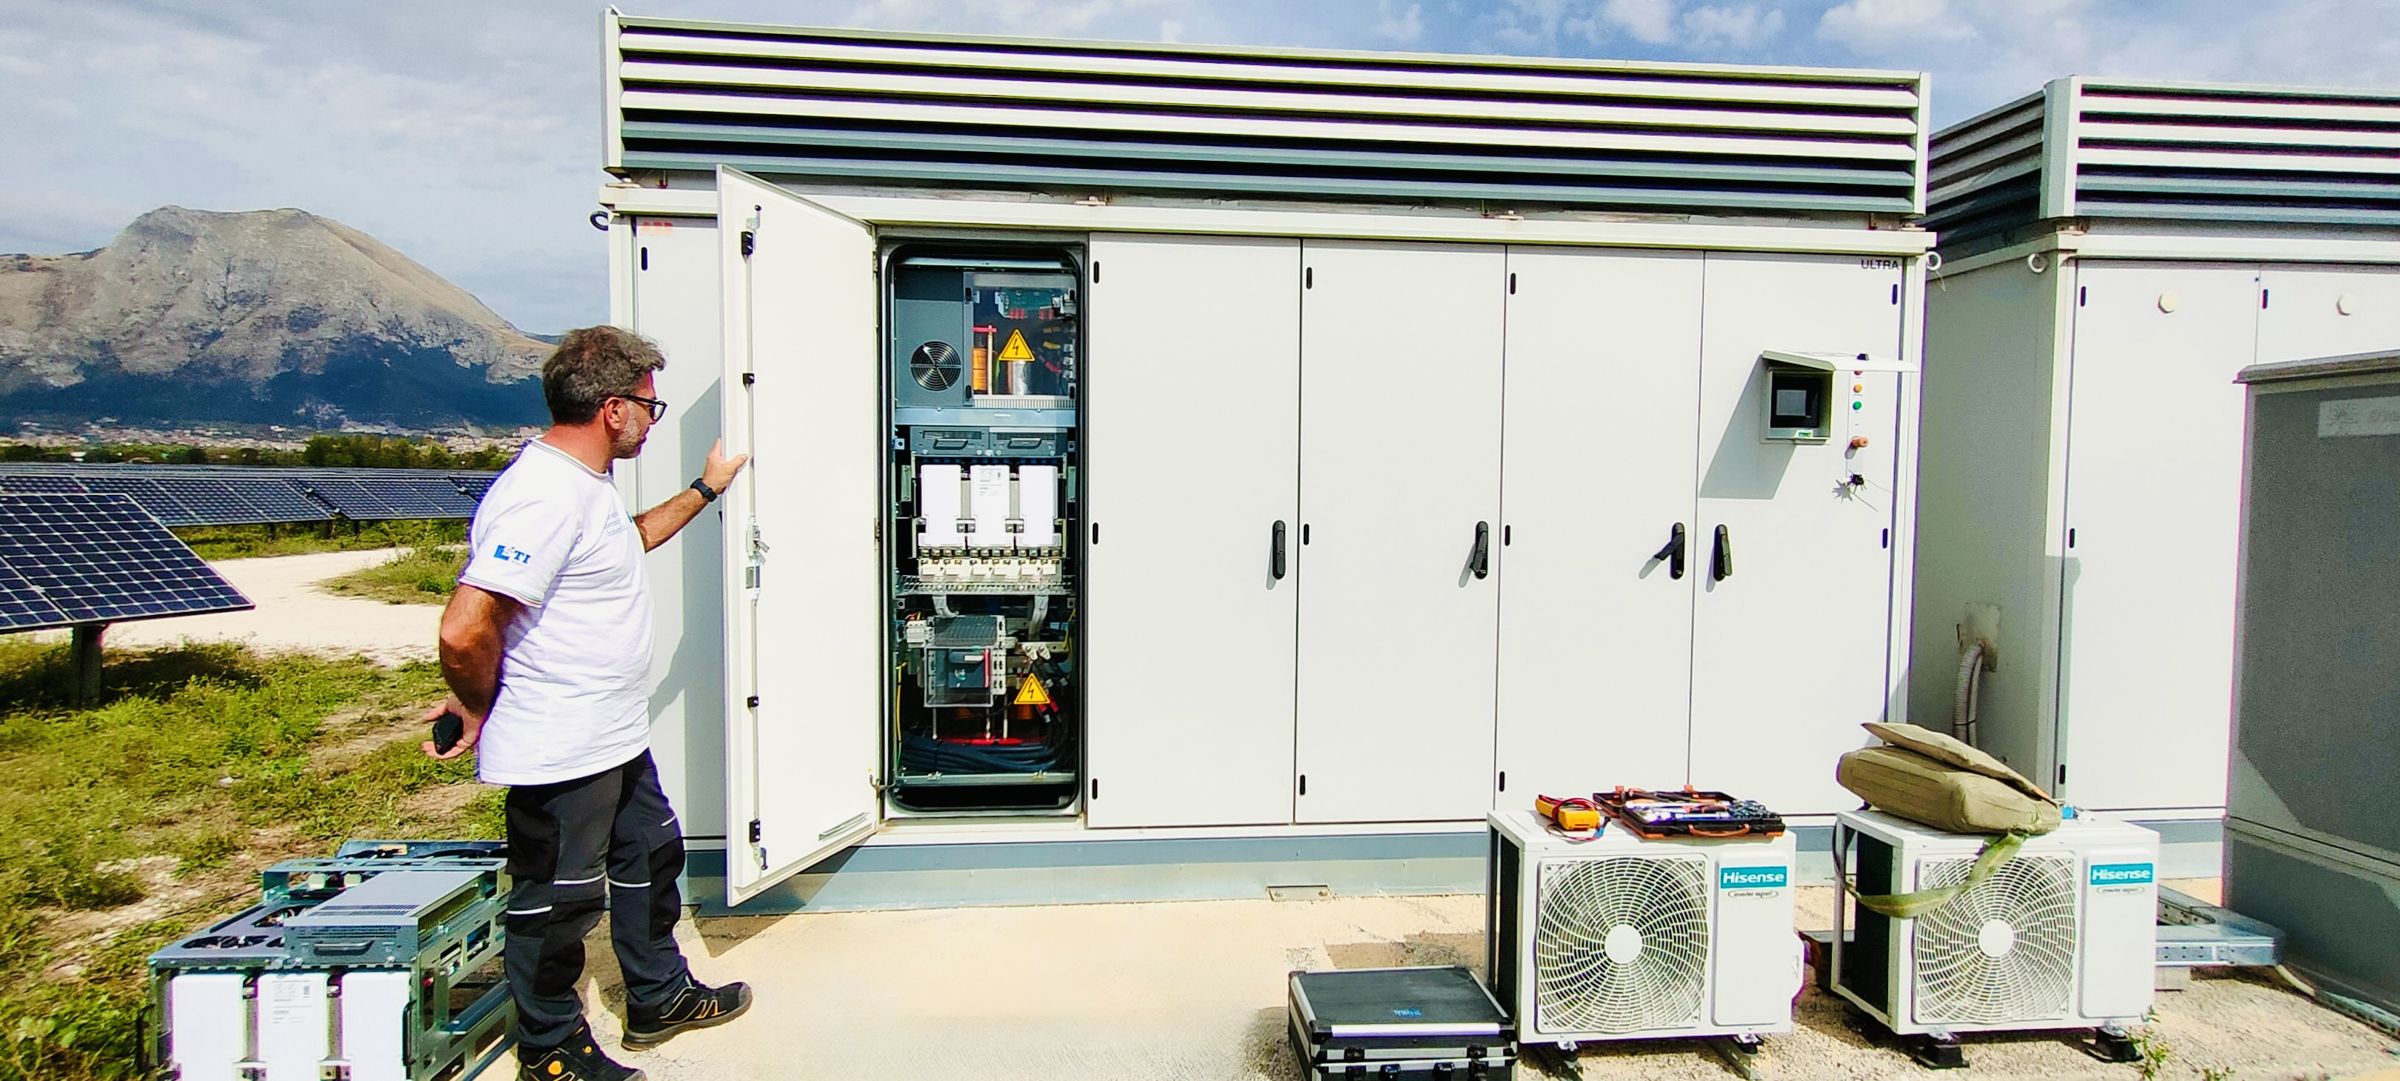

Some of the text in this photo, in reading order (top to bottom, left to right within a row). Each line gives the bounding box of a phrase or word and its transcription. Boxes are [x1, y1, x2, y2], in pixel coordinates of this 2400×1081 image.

[1861, 259, 1899, 270] ULTRA
[1723, 872, 1785, 884] Hisense
[2092, 869, 2151, 881] Hisense
